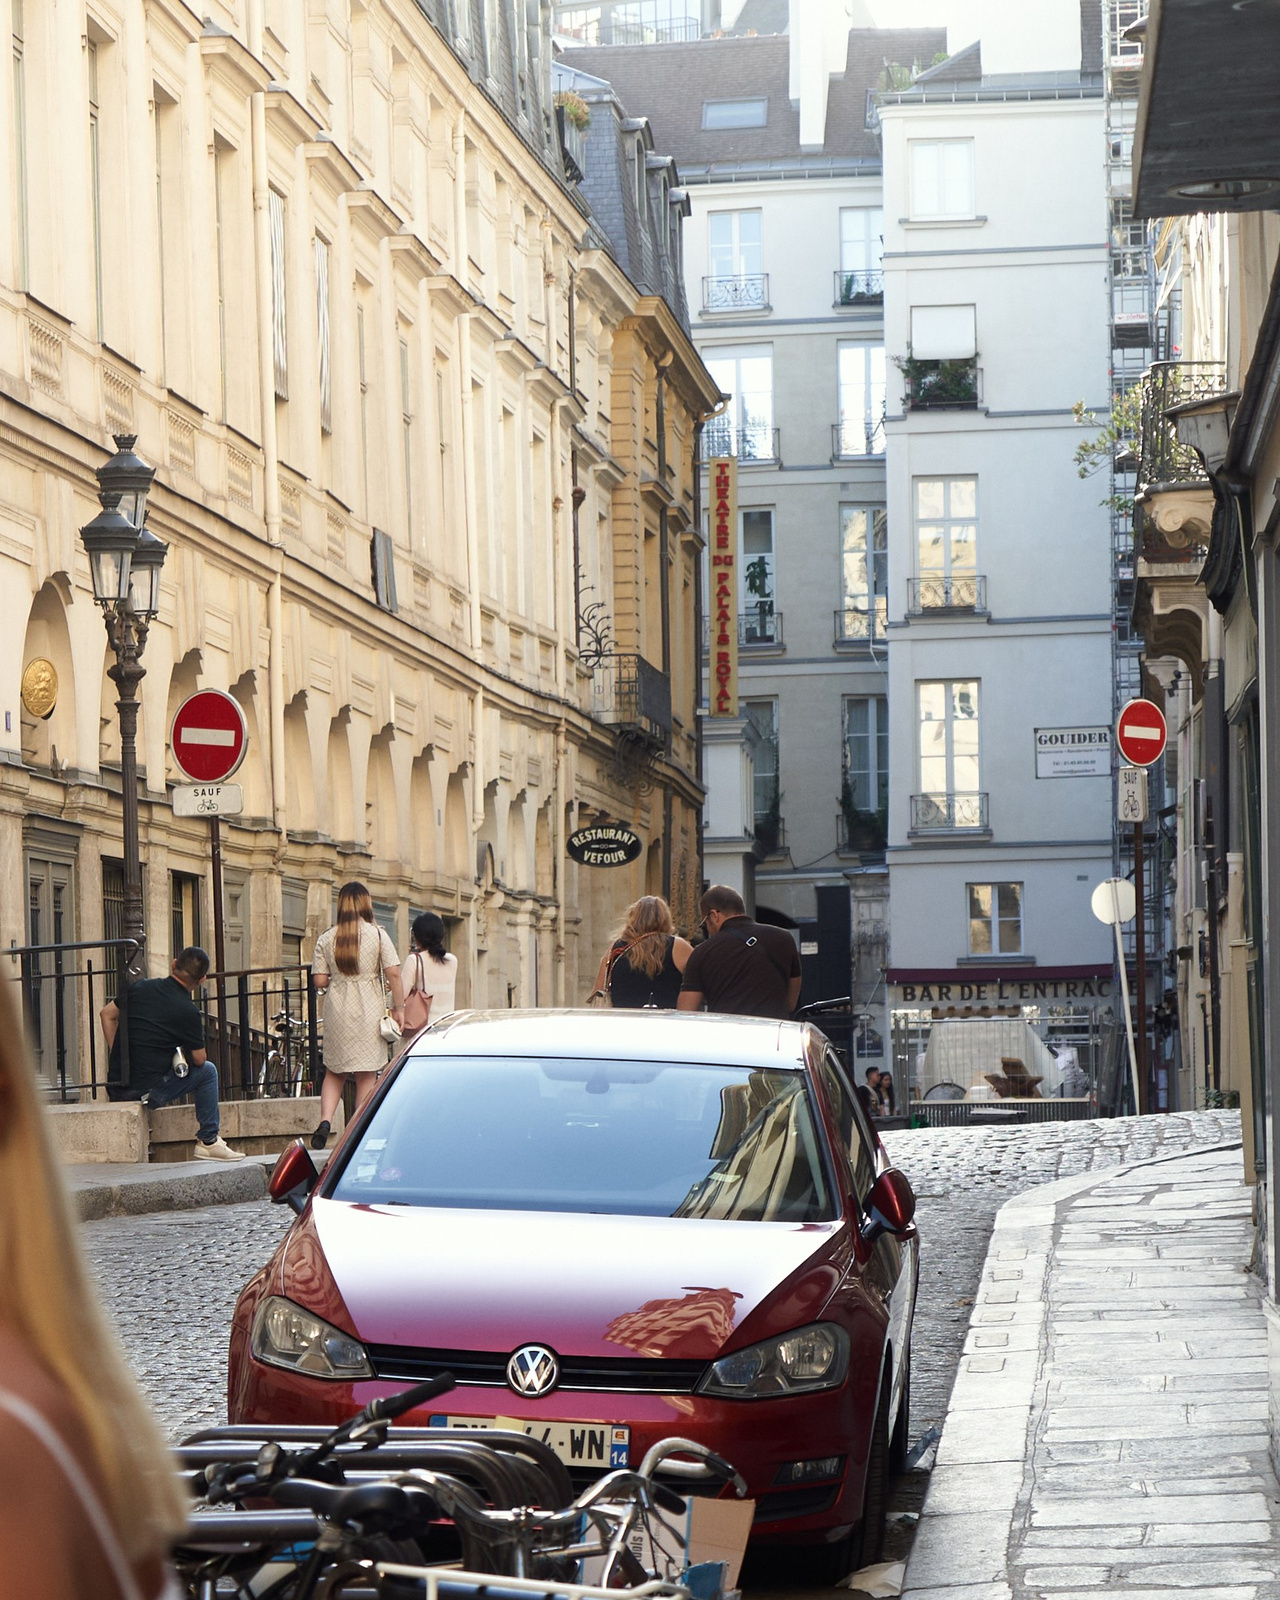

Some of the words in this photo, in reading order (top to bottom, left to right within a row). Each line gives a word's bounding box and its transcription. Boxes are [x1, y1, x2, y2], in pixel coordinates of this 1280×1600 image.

[716, 463, 730, 549] THEATRE
[713, 555, 733, 567] DU
[715, 572, 732, 646] PALAIS
[716, 652, 732, 713] ROYAL
[1038, 732, 1109, 746] GOUIDER
[1124, 772, 1137, 784] SAUF
[193, 787, 222, 797] SAUF
[571, 828, 637, 847] RESTAURANT
[583, 849, 627, 864] VEFOUR
[903, 985, 952, 1001] BAR
[960, 984, 988, 1001] DE
[998, 980, 1139, 1000] L'ENTRACE
[611, 1450, 628, 1466] 14
